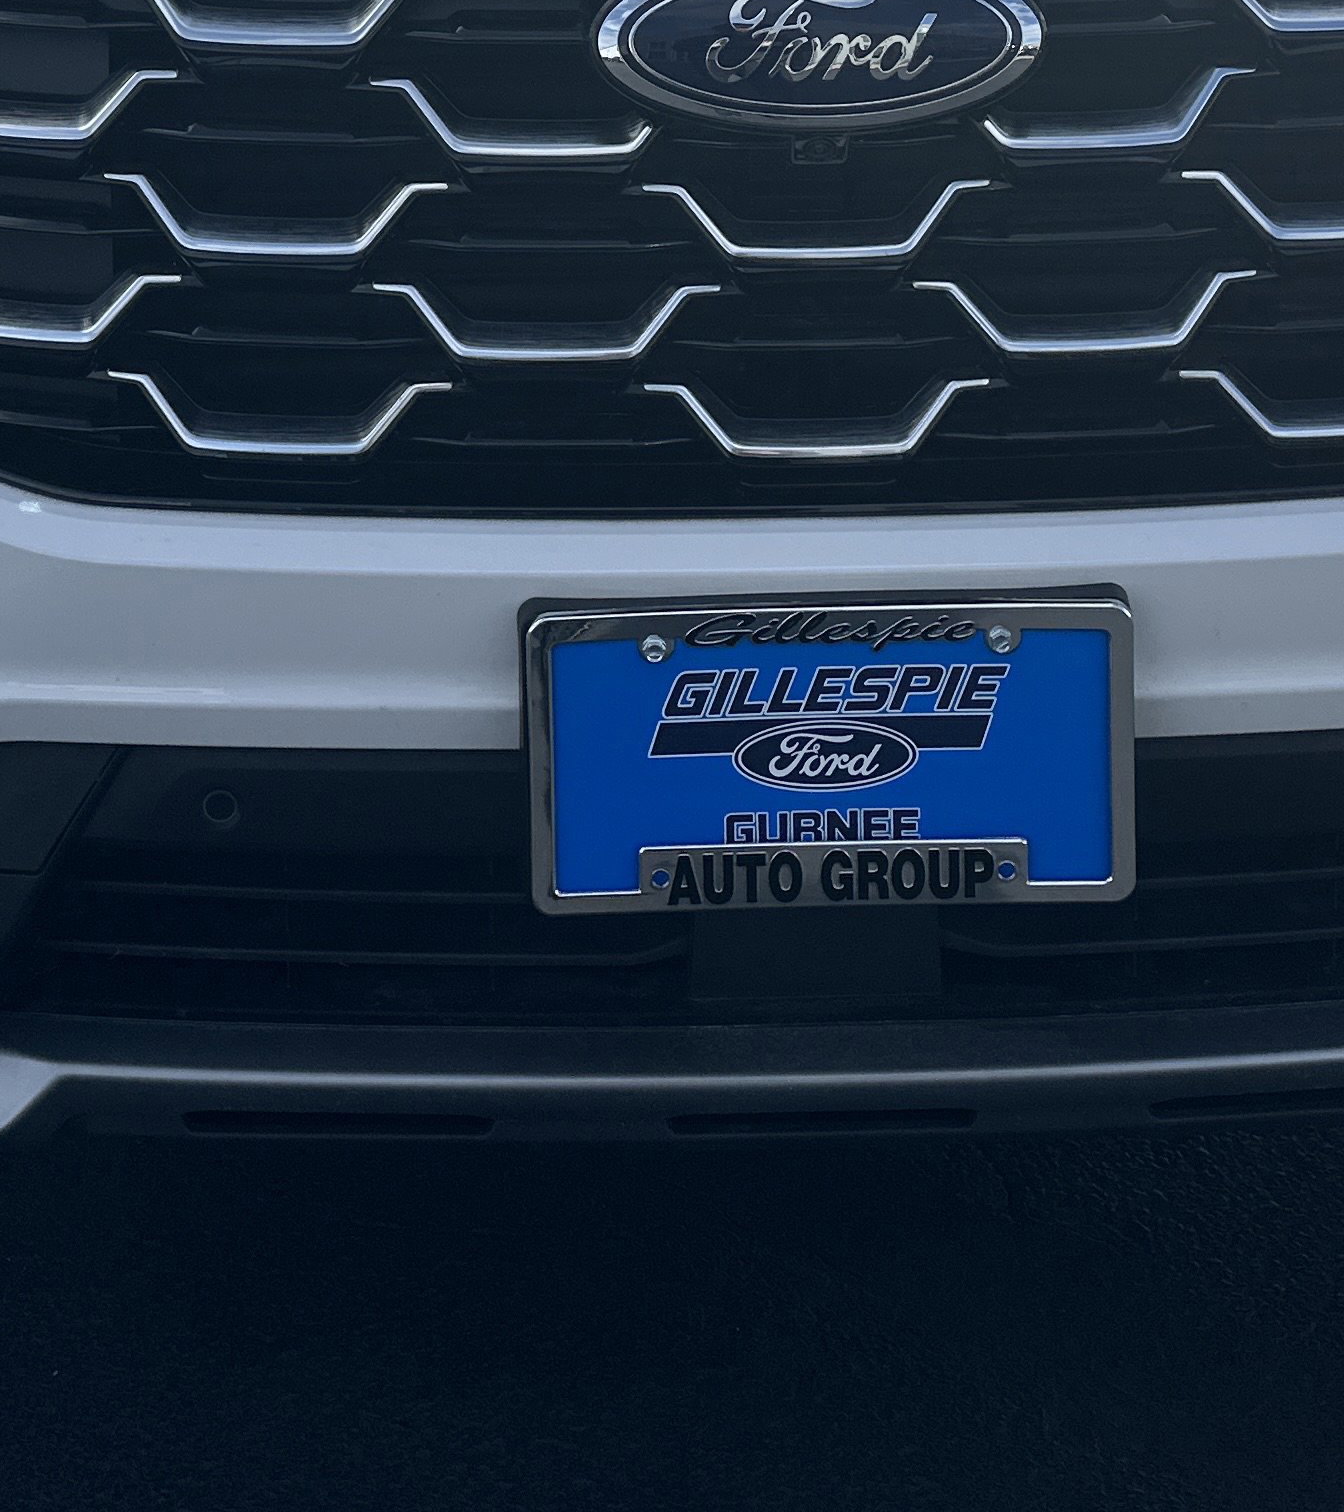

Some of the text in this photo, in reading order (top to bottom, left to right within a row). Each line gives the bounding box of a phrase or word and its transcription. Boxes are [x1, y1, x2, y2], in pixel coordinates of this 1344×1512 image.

[685, 611, 976, 652] Gillespie
[661, 664, 1010, 719] GILLESPIE
[768, 732, 881, 777] Ford
[724, 807, 921, 844] GURNEE
[667, 847, 995, 906] AUTO GROUP
